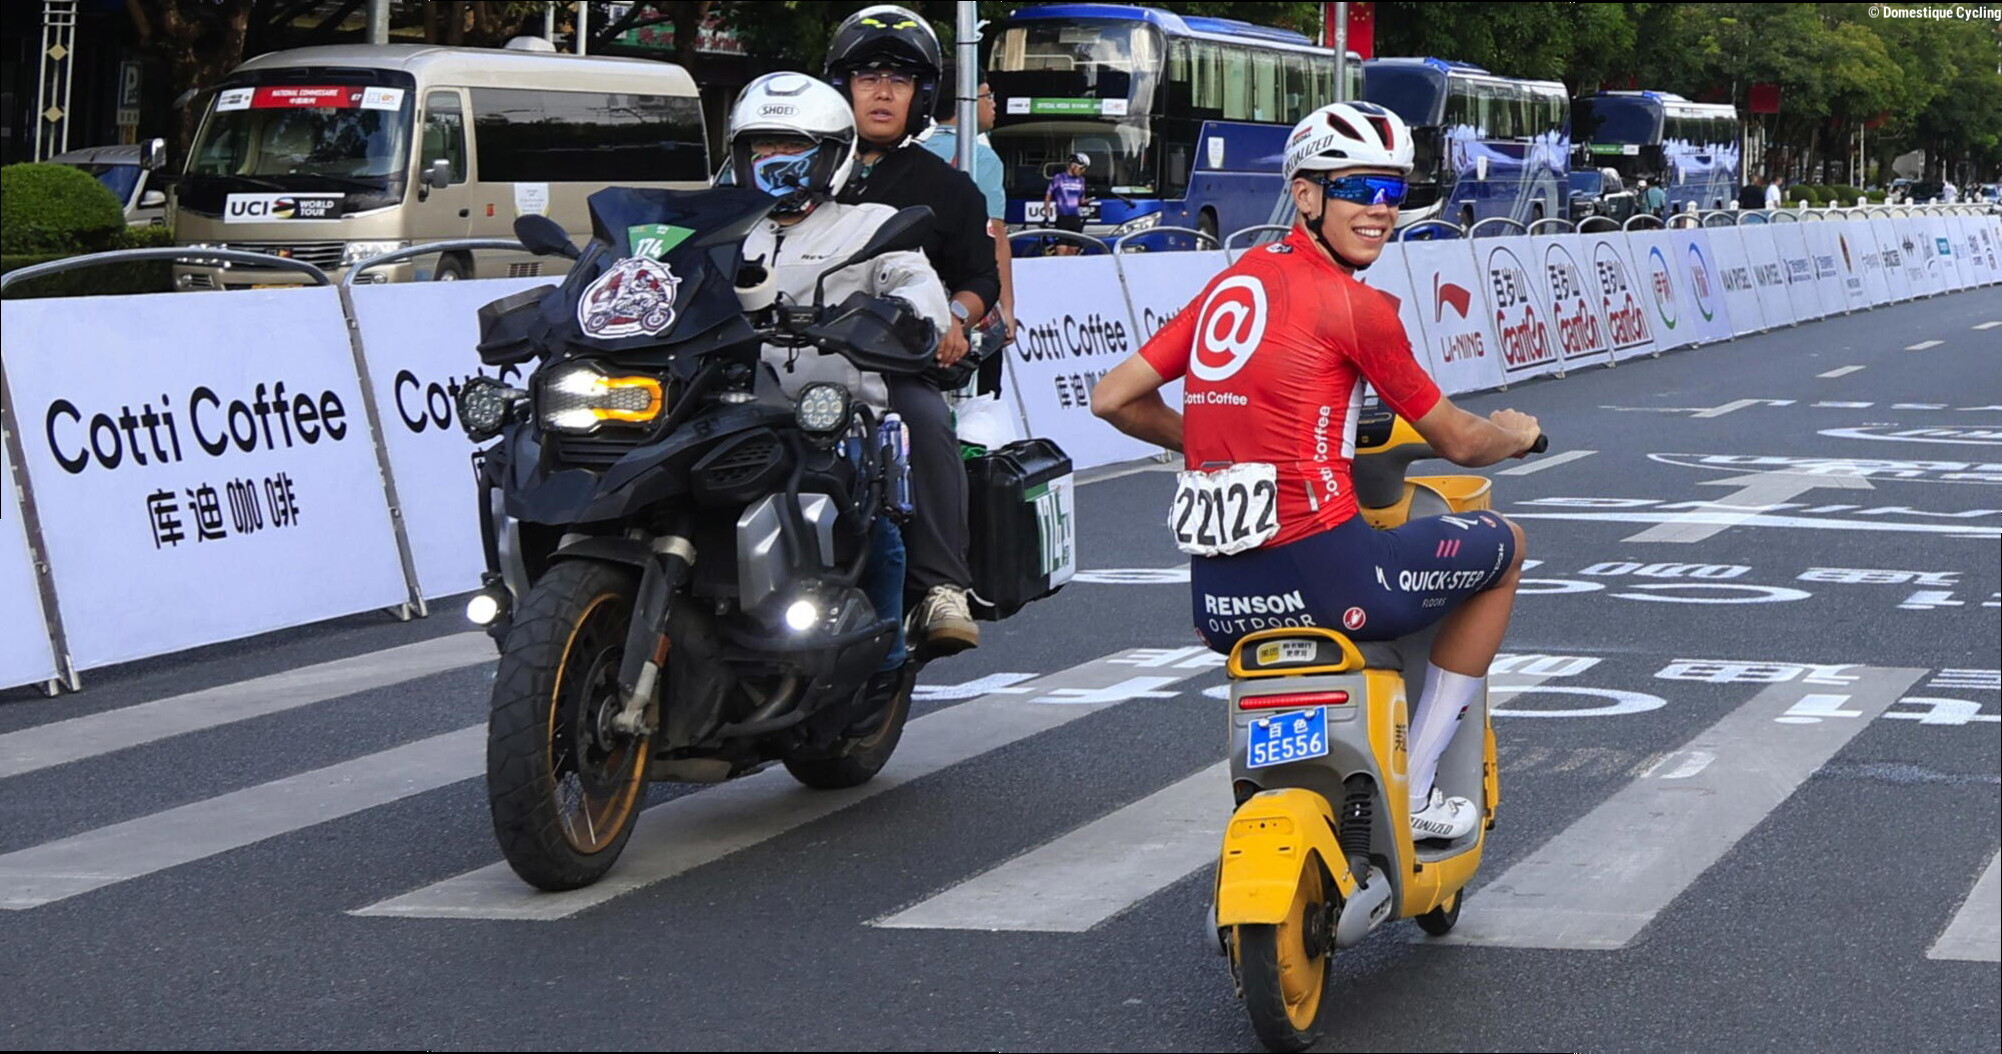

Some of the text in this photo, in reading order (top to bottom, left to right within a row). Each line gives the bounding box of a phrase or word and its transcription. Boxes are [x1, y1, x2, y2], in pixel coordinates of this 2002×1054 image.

[762, 105, 794, 116] SHOEI
[231, 200, 269, 217] UCI
[299, 200, 335, 209] WORLD
[300, 208, 326, 217] TOUR
[633, 238, 665, 259] 174
[1013, 313, 1127, 363] Cotti Coffee
[1207, 391, 1248, 406] Coffee
[46, 381, 347, 474] Cotti Coffee
[146, 472, 300, 550] 库迪咖啡
[1204, 590, 1306, 616] RENSON
[1208, 613, 1317, 635] OUTDOOR
[1268, 717, 1309, 740] 百色
[1254, 732, 1323, 764] 5E556
